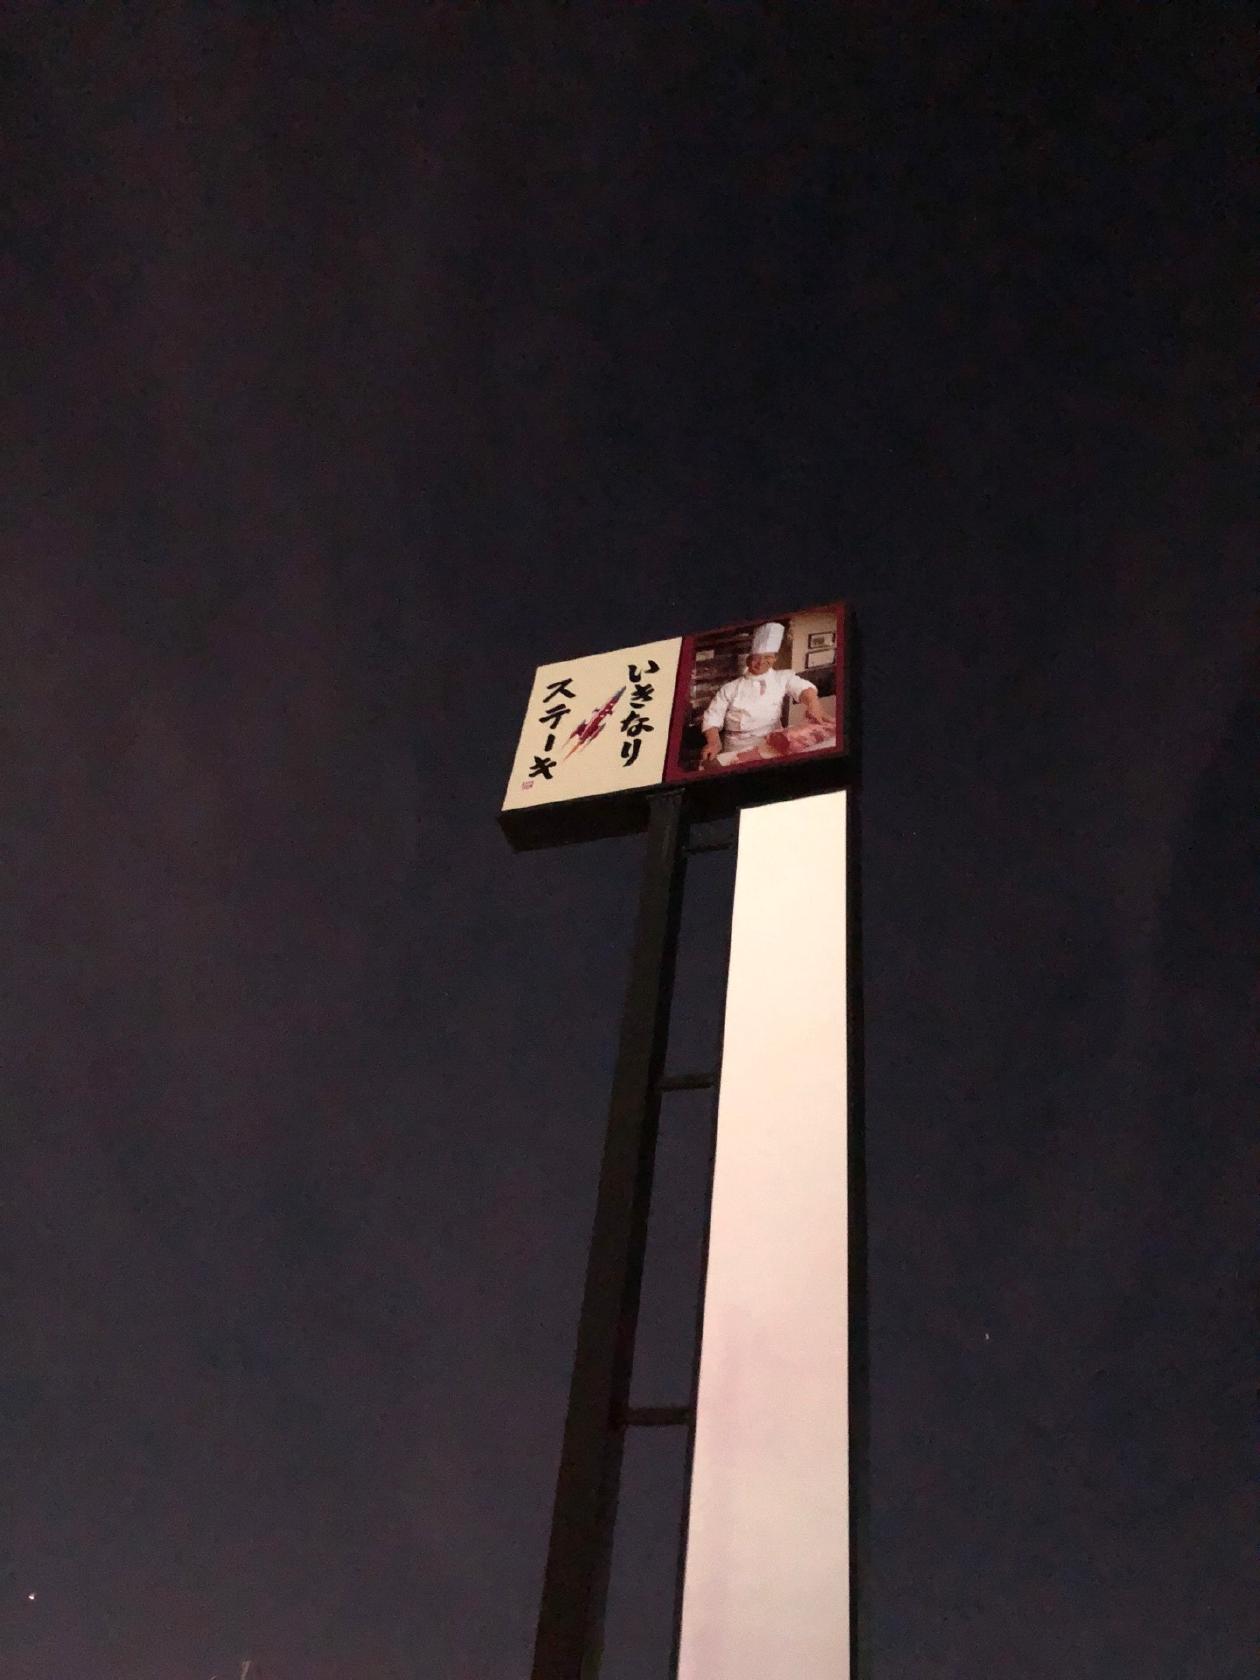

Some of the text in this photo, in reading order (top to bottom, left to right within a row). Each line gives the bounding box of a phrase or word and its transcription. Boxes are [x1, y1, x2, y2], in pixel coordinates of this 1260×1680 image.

[529, 678, 576, 780] ステーキ
[620, 660, 660, 767] いきなり
